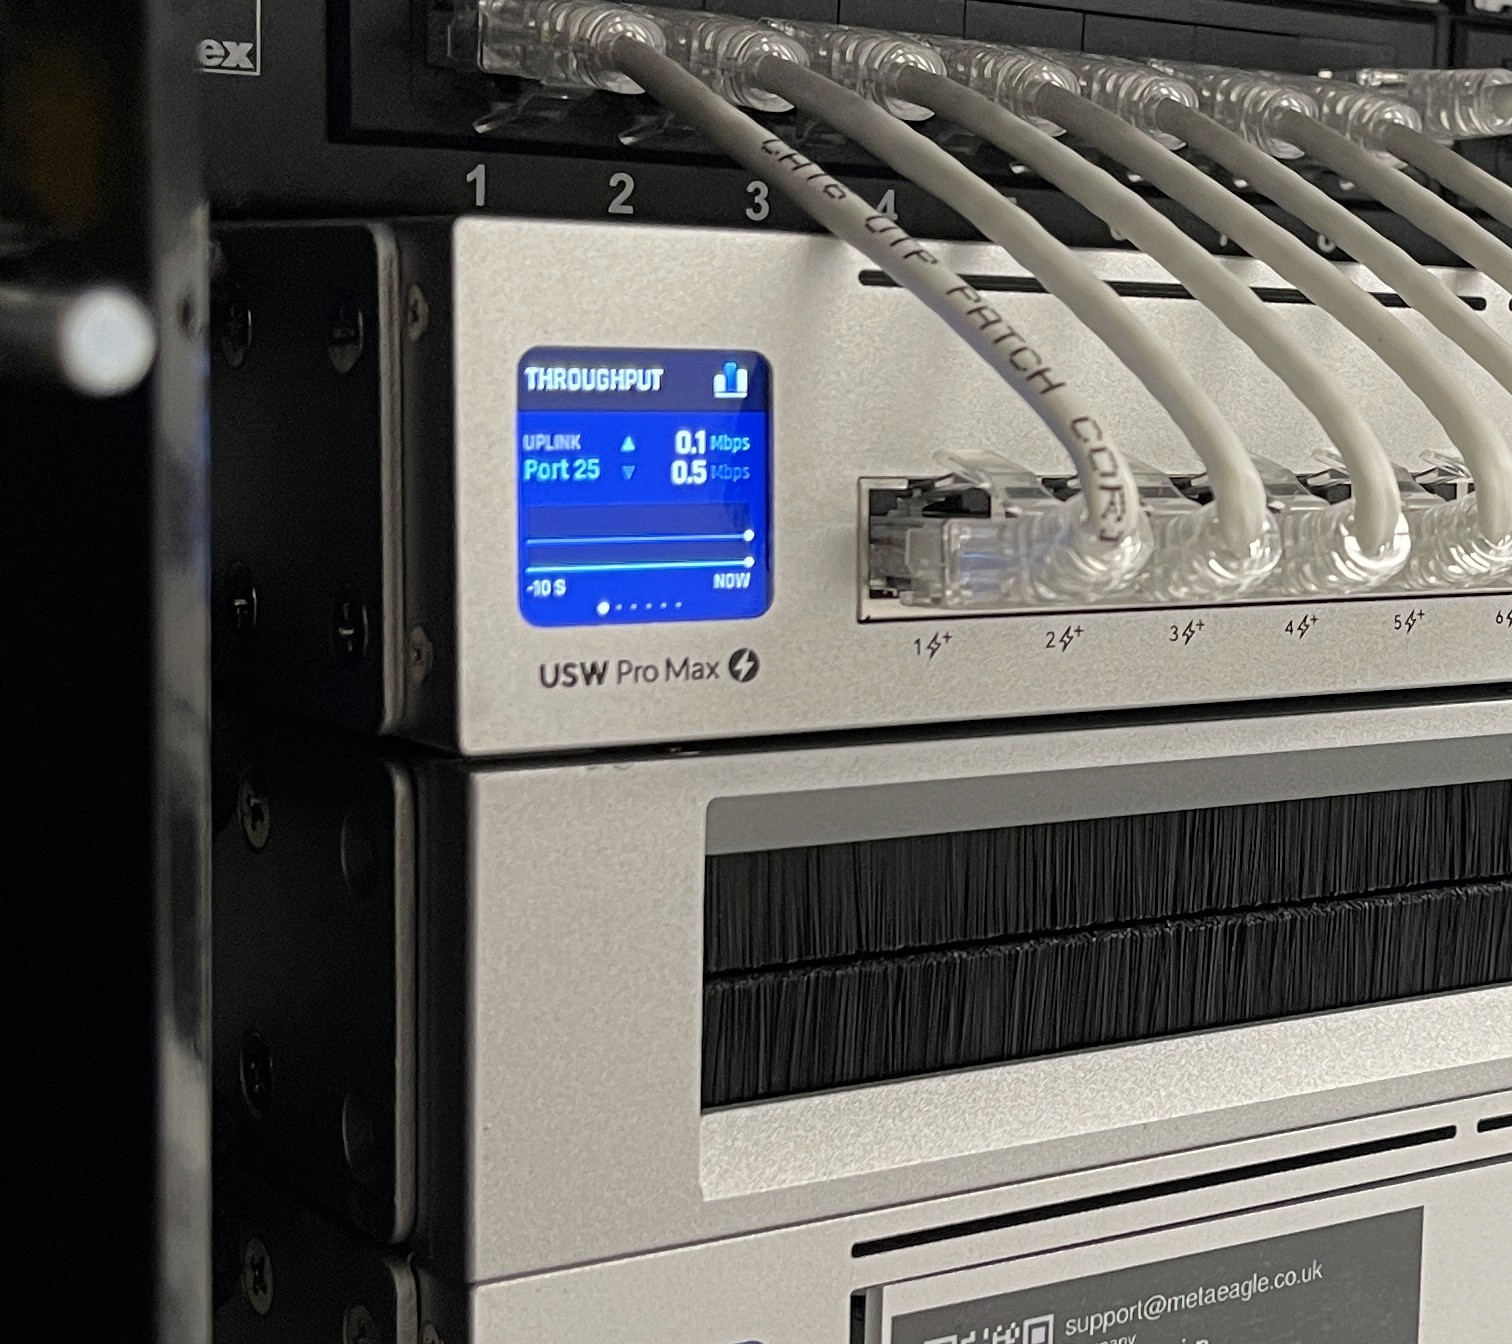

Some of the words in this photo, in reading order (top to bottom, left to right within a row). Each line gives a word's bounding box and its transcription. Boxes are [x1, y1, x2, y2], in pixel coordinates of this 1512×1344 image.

[466, 164, 486, 206] 1
[608, 172, 635, 214] 2
[746, 181, 770, 221] 3
[946, 286, 1066, 394] PATCH
[524, 366, 665, 391] THROUGHPUT
[522, 433, 581, 451] UPLINK
[674, 429, 706, 455] 0.1
[709, 434, 751, 455] Mbps
[523, 459, 570, 482] Port
[572, 457, 601, 481] 25
[670, 459, 708, 485] 0.5
[710, 464, 751, 483] Mbps
[526, 579, 551, 598] -10
[553, 578, 567, 597] S
[712, 572, 751, 590] NOW
[539, 659, 609, 689] USW
[616, 659, 659, 685] Pro
[665, 656, 720, 682] Max
